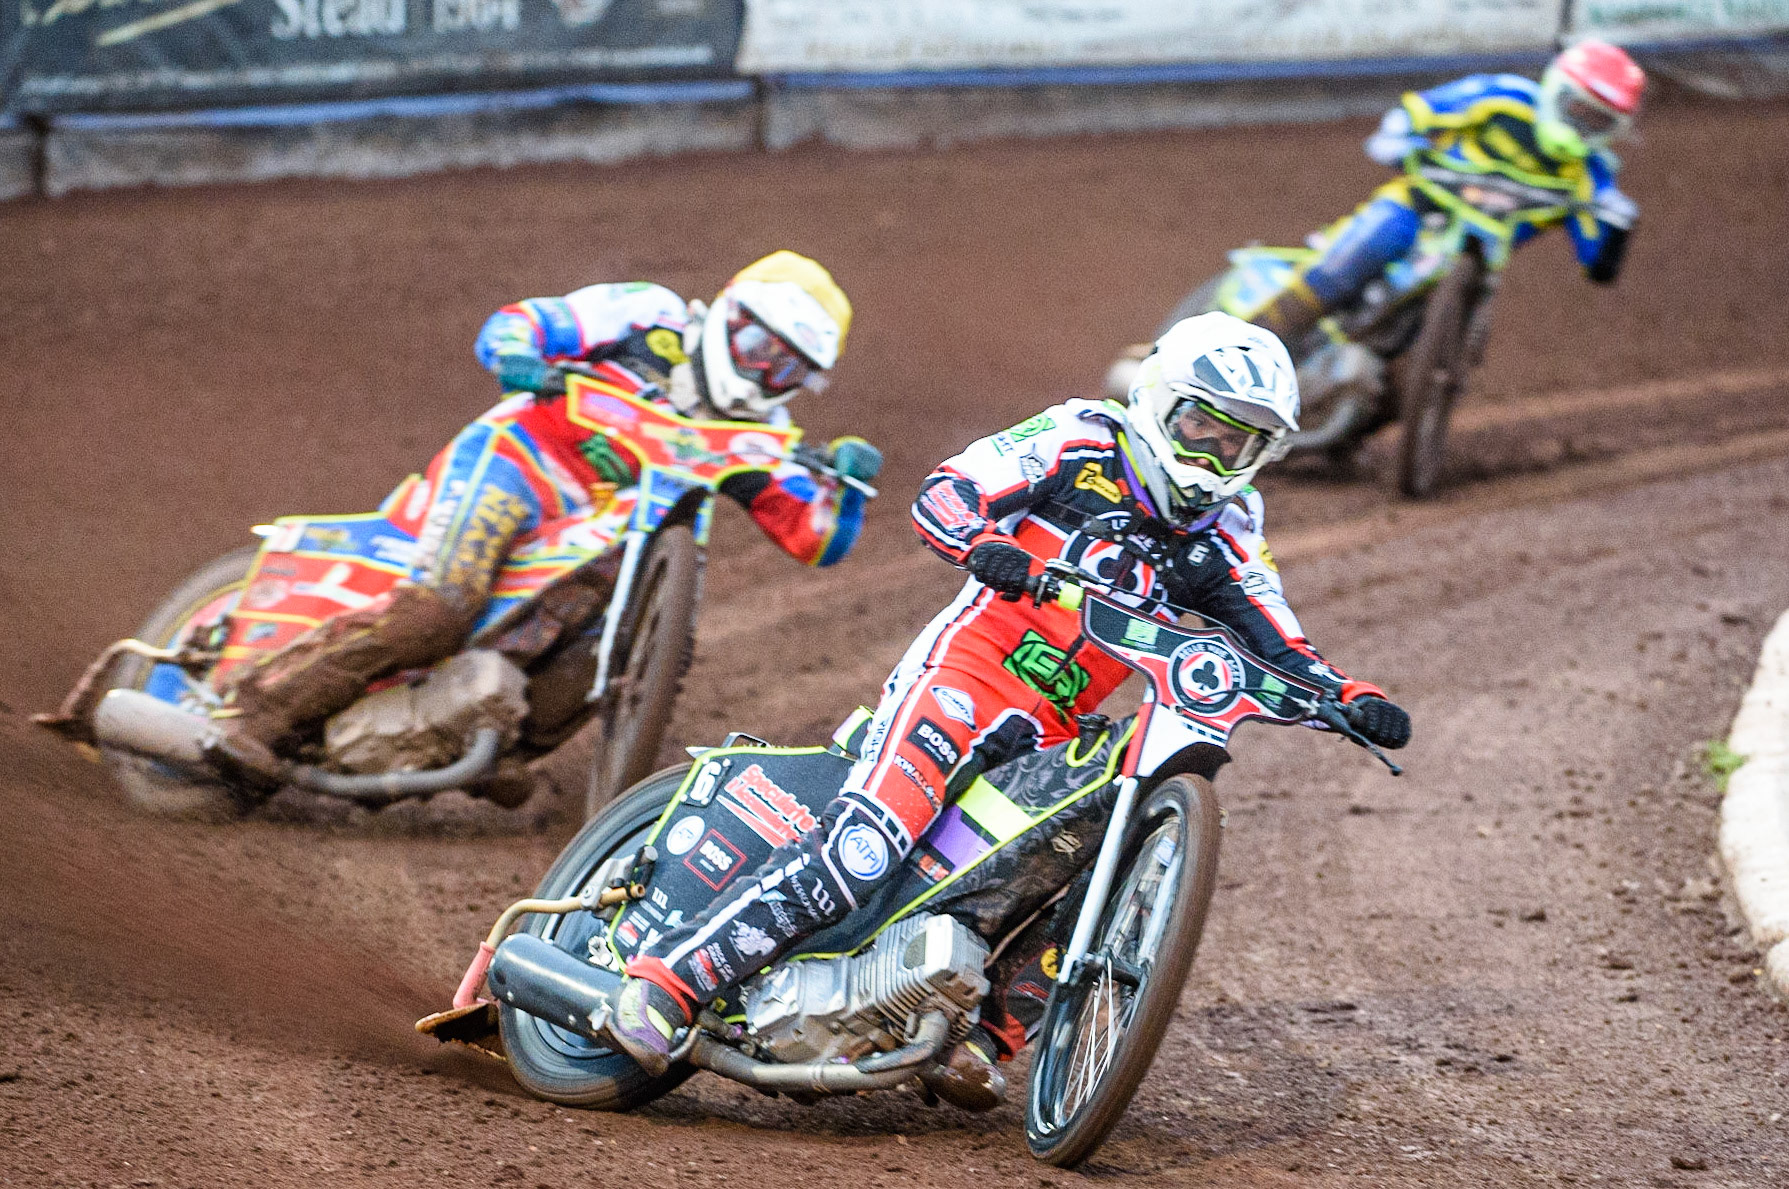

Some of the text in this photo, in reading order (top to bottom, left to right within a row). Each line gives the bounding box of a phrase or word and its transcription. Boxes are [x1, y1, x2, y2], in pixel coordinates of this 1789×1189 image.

[917, 723, 958, 765] BOSS
[690, 761, 722, 801] 6
[699, 838, 734, 872] BOSS
